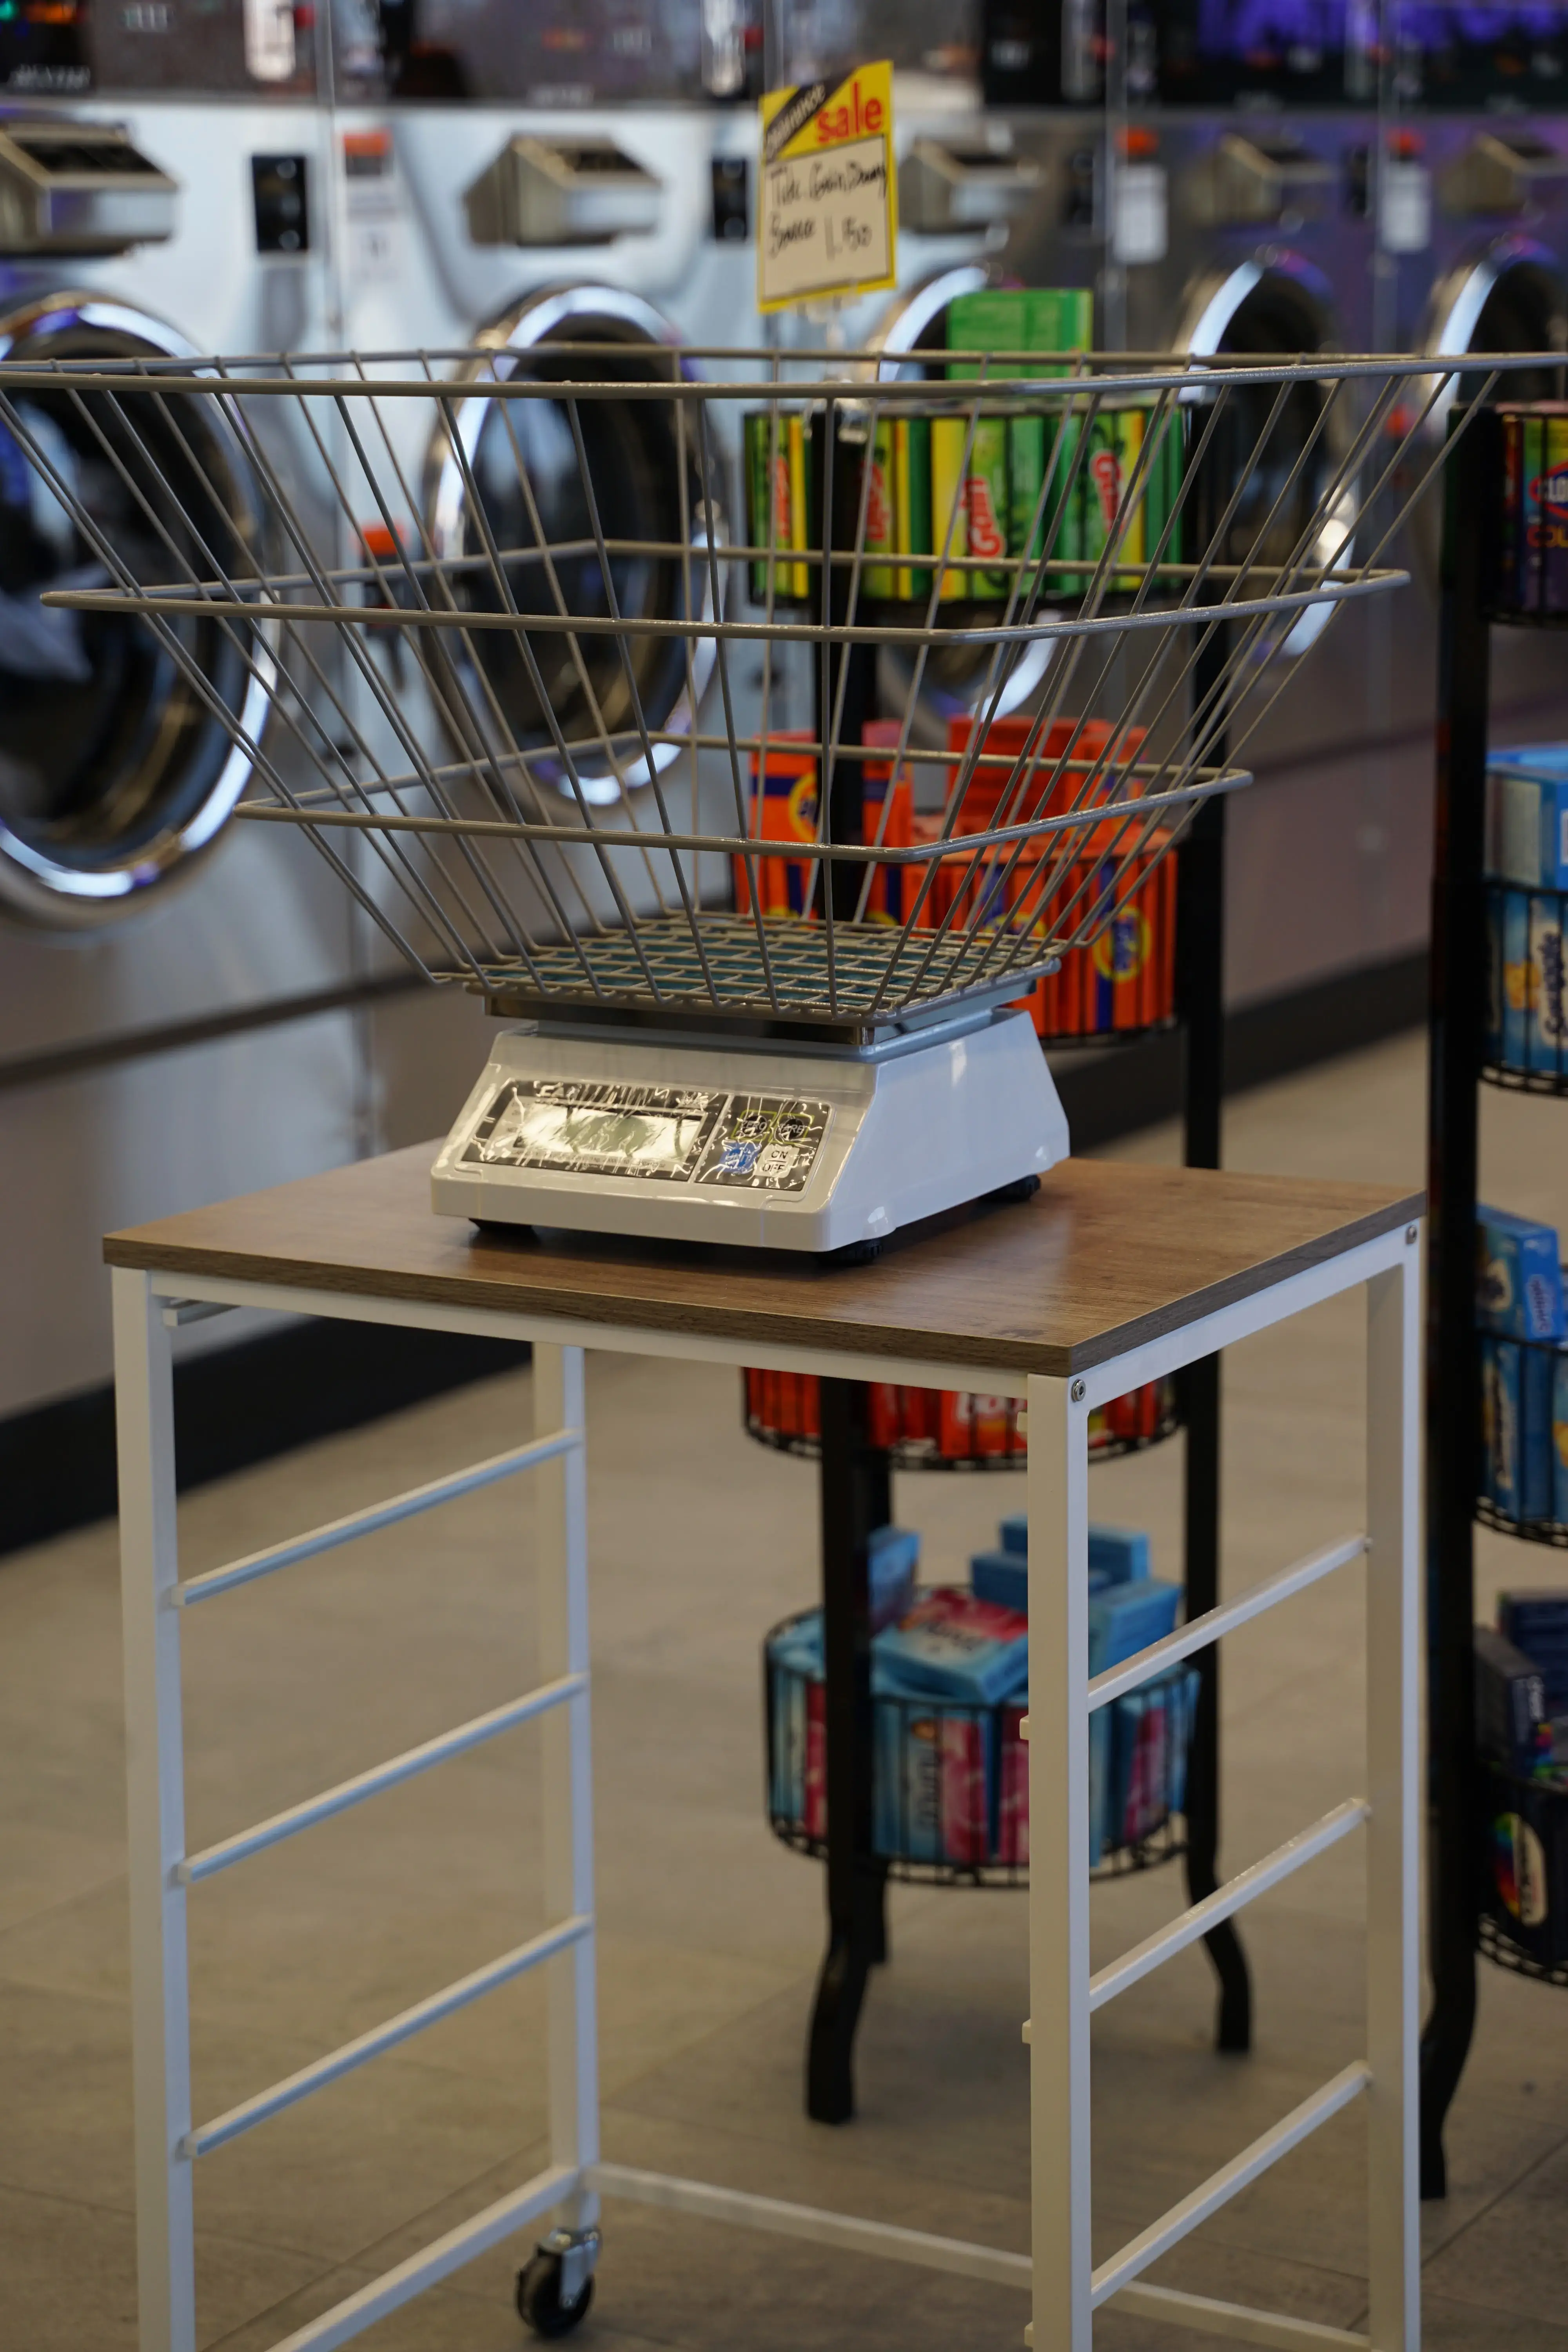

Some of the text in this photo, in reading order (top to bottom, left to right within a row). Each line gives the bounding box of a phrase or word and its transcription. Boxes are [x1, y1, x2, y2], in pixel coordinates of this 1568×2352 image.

[818, 82, 882, 143] sale
[742, 1120, 768, 1131] ZERO
[771, 1150, 788, 1159] ON
[762, 1164, 785, 1172] OFF
